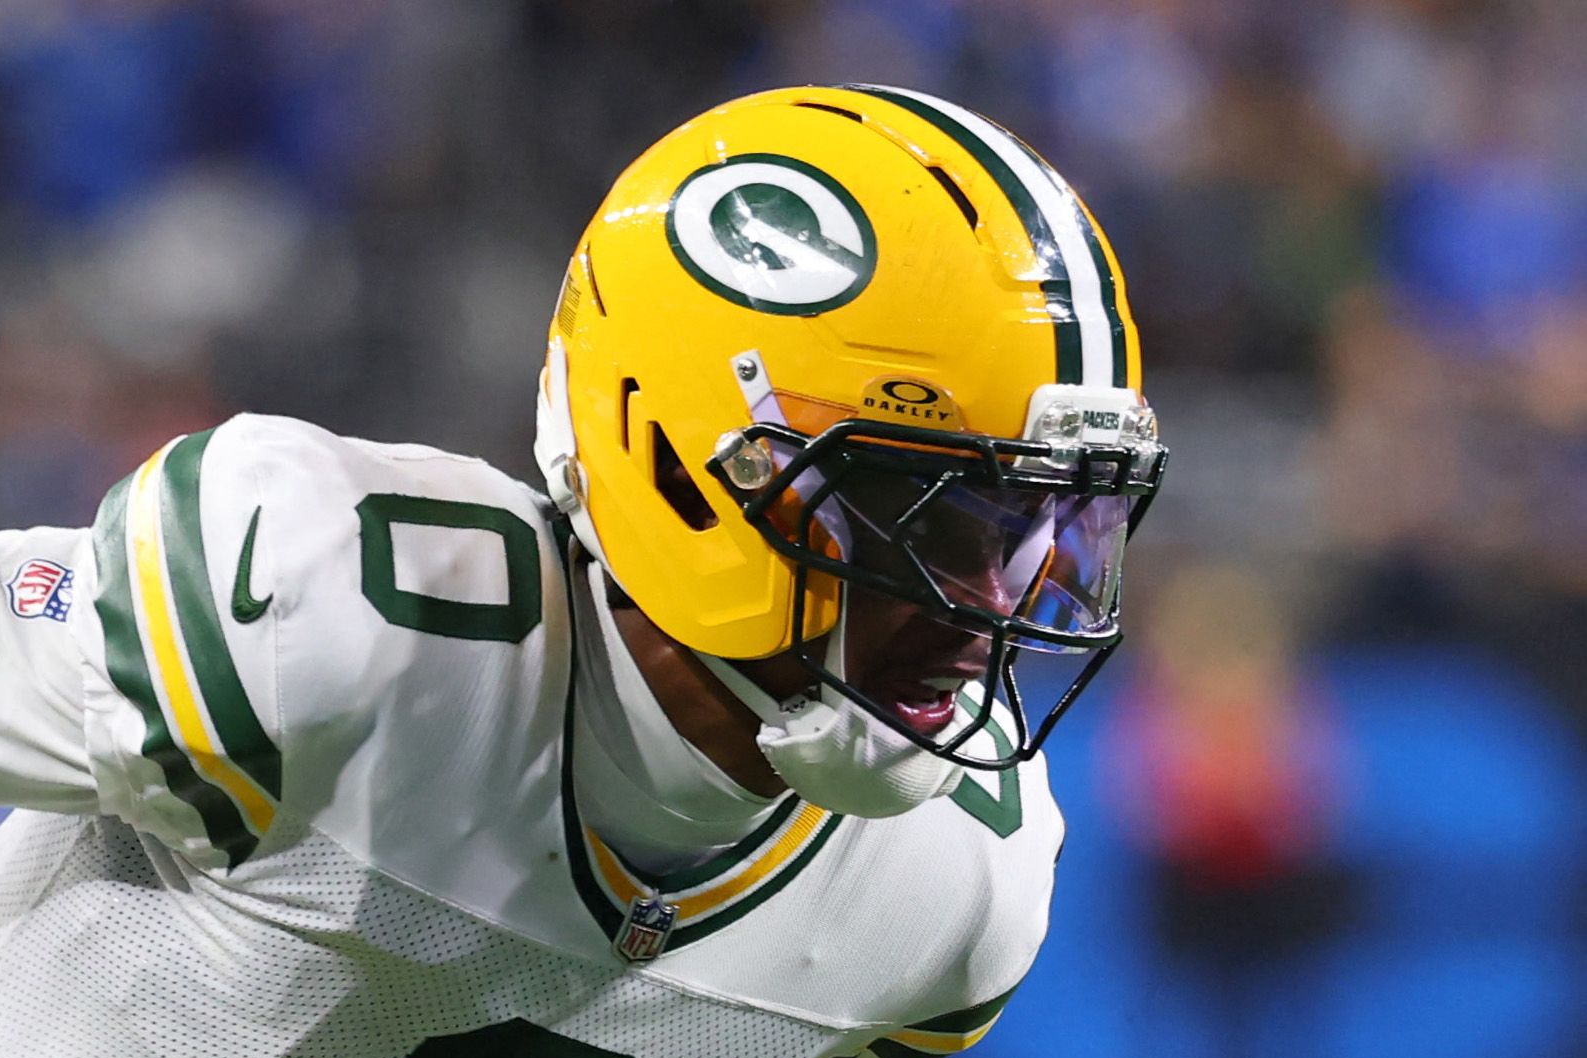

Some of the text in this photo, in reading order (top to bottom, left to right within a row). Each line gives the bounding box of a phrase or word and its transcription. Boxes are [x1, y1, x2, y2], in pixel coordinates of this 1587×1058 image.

[864, 397, 949, 421] OAKLEY
[1083, 410, 1120, 430] PACKERS
[17, 562, 61, 613] NFL
[622, 925, 662, 957] NFL
